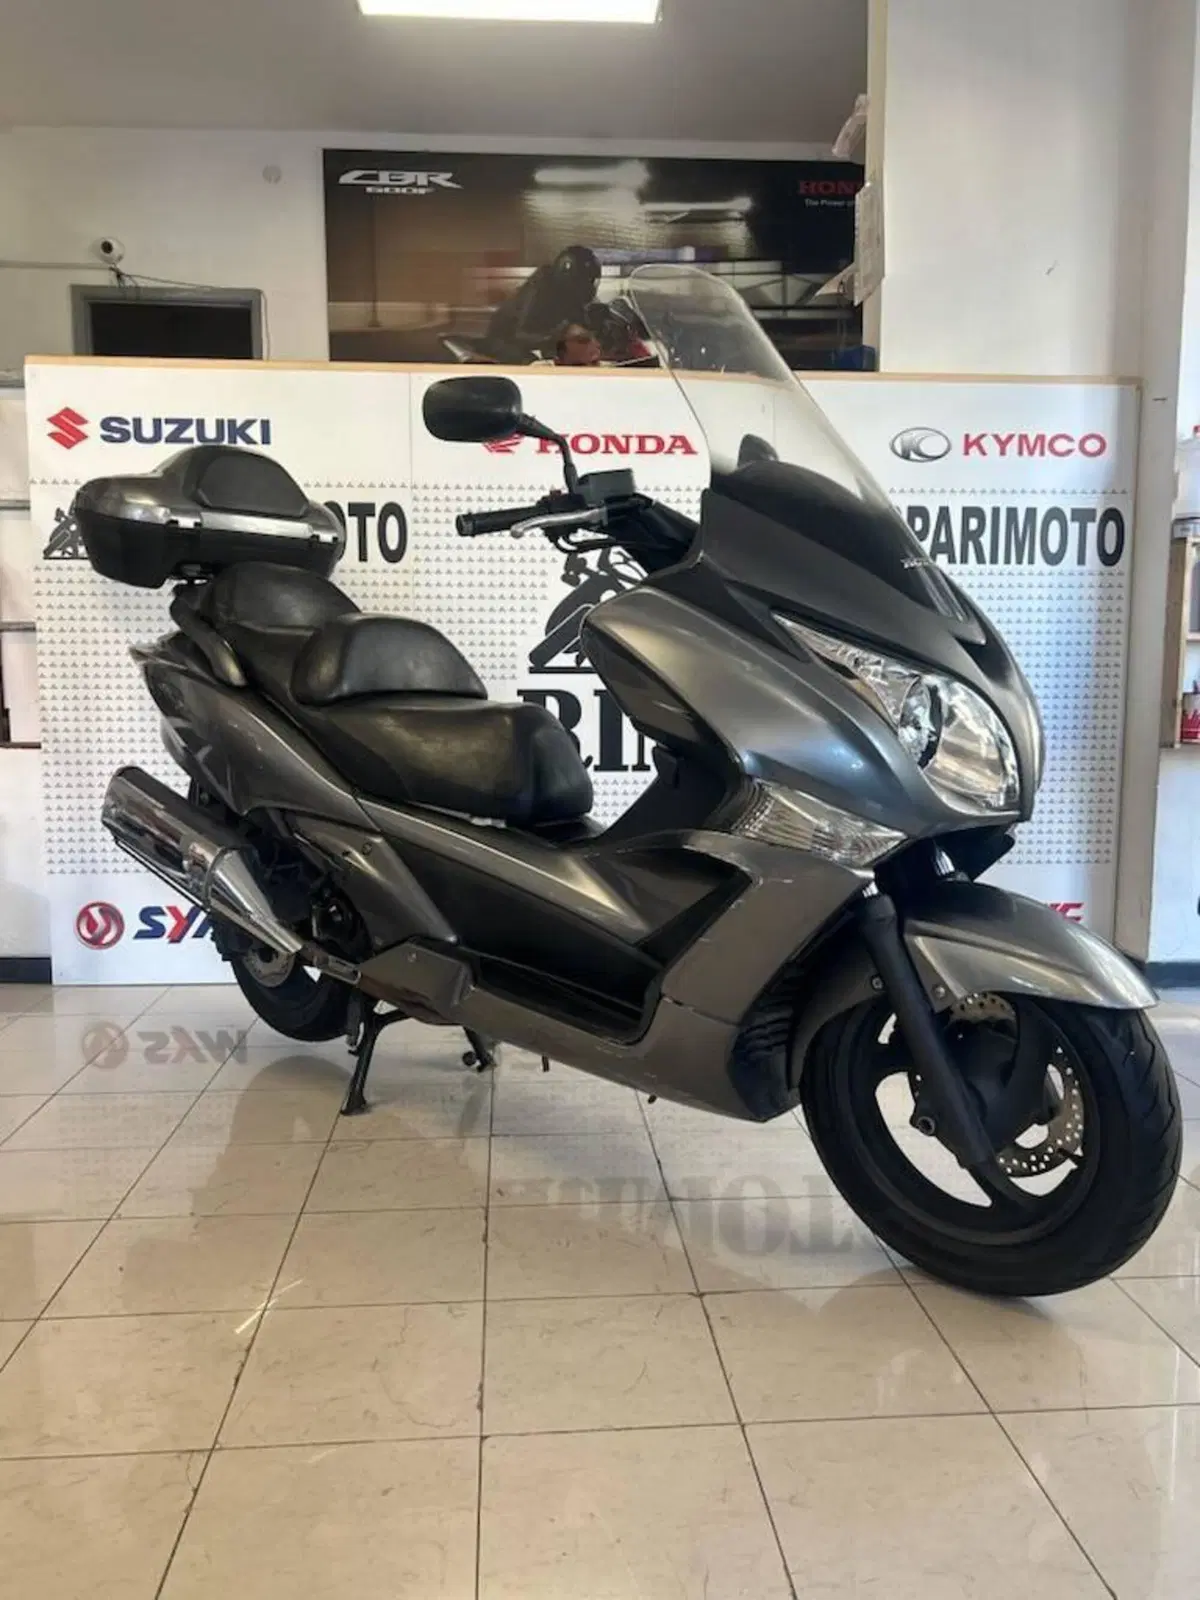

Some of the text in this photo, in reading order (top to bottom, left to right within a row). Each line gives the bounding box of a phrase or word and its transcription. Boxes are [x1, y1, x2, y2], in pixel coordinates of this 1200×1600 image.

[338, 169, 463, 189] CBR
[99, 416, 269, 445] SUZUKI
[963, 433, 1107, 457] KYMCO
[906, 505, 1125, 567] PARIMOTO
